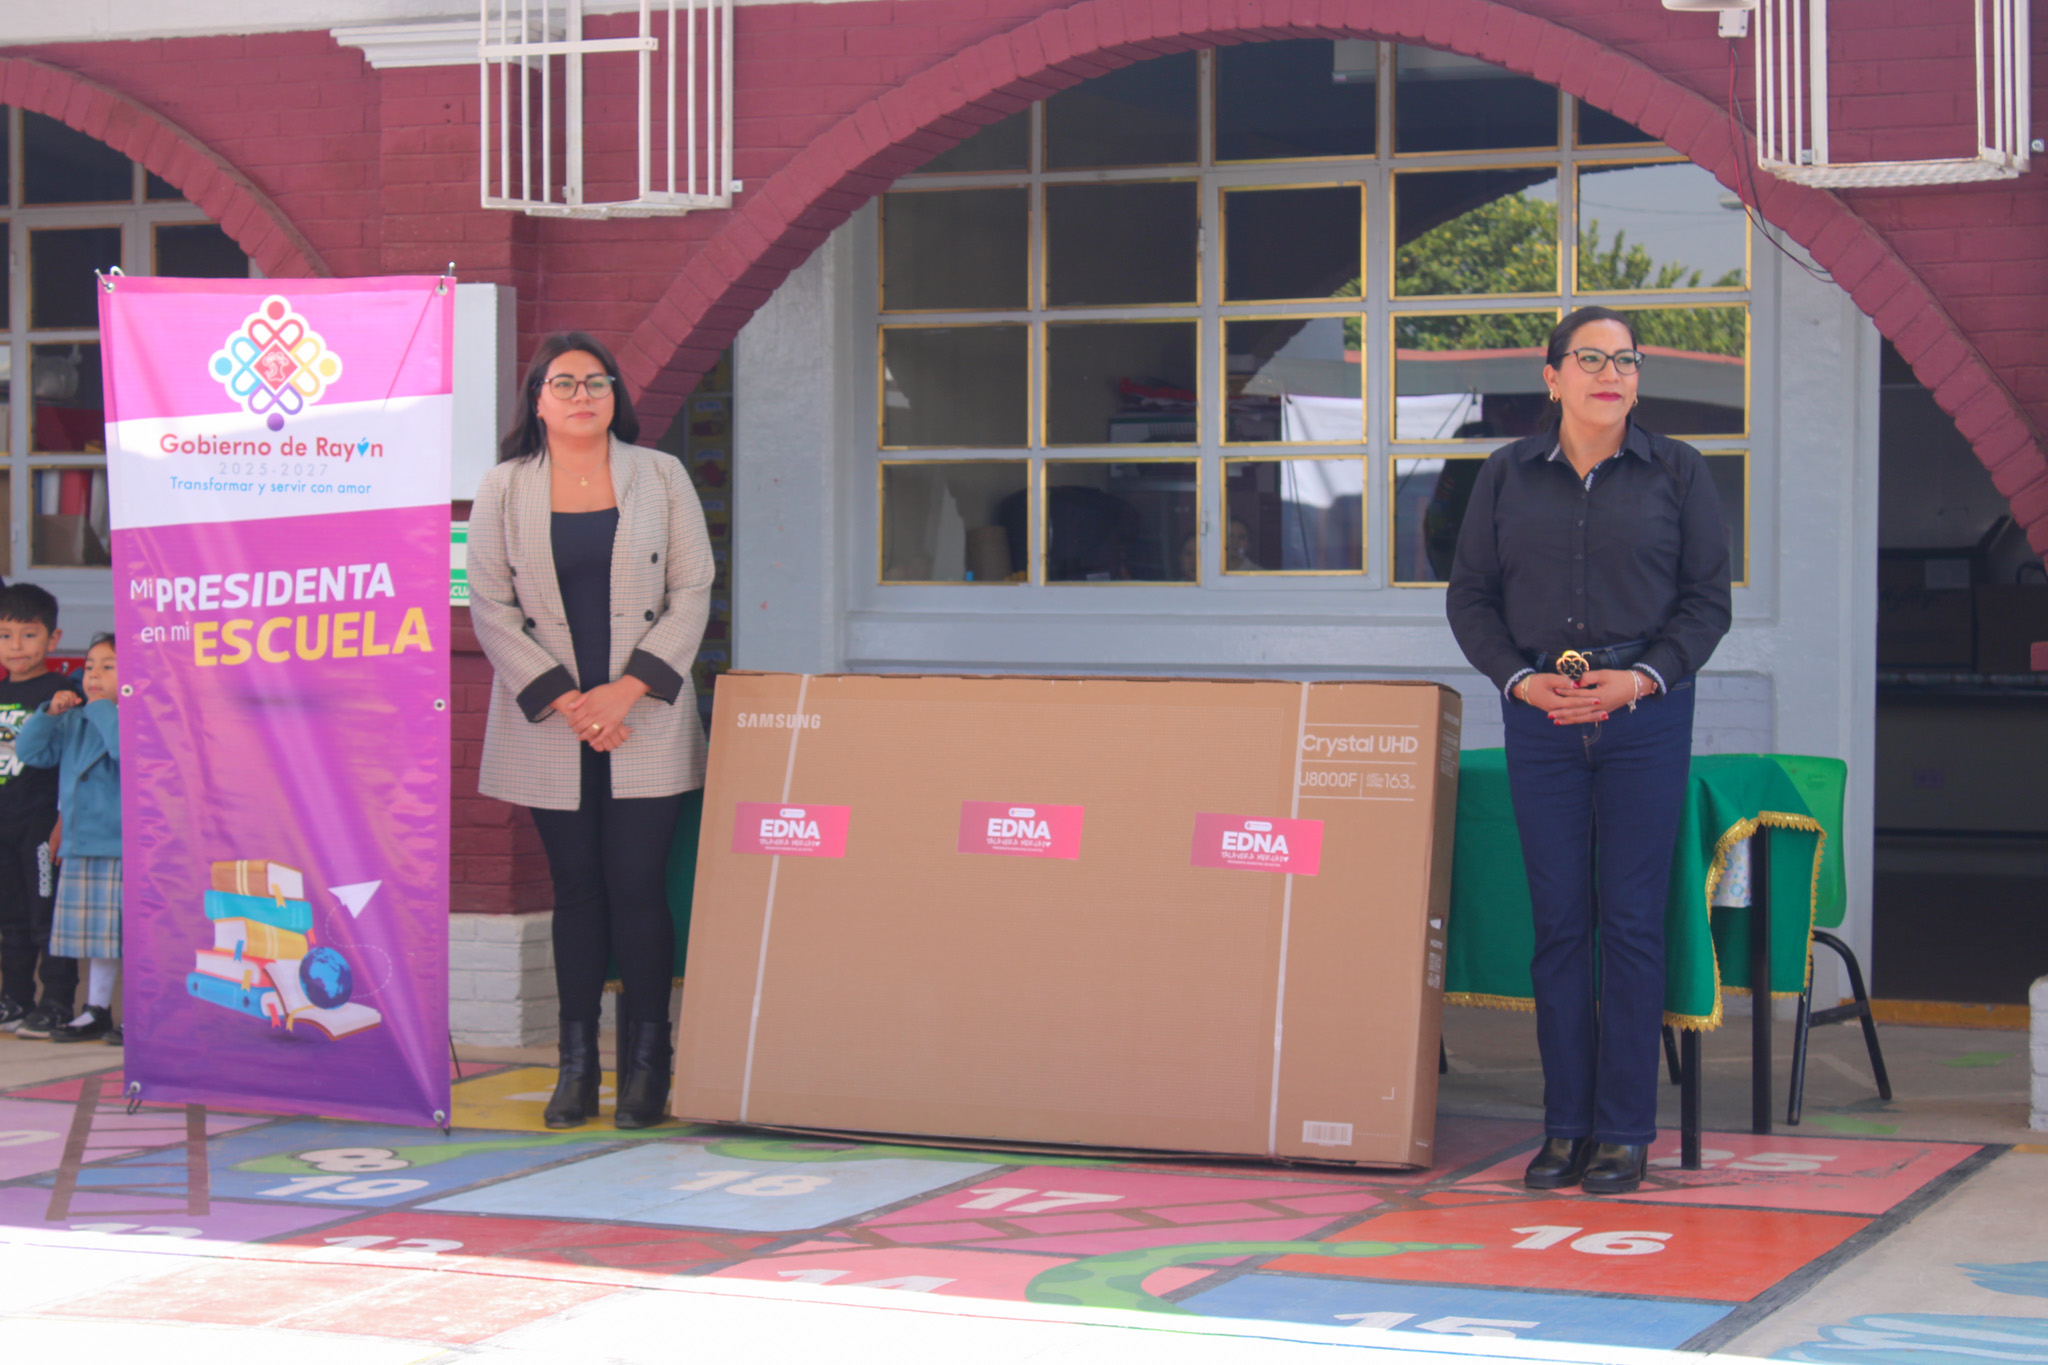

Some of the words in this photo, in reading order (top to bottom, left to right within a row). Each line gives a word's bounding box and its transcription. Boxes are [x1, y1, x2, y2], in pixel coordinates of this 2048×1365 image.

[160, 433, 271, 456] Gobierno
[281, 436, 307, 456] de
[218, 462, 328, 477] 2025-2027
[170, 476, 253, 493] Transformar
[258, 482, 266, 496] y
[270, 480, 306, 494] servir
[310, 482, 333, 494] con
[337, 482, 372, 495] amor
[130, 579, 153, 600] Mi
[156, 562, 395, 612] PRESIDENTA
[140, 625, 165, 643] en
[170, 621, 190, 642] mi
[193, 607, 433, 667] ESCUELA
[737, 712, 822, 729] SAMSUNG
[1301, 734, 1374, 758] Crystal
[1378, 735, 1419, 754] UHD
[759, 818, 821, 840] EDNA
[986, 818, 1051, 840] EDNA
[1222, 830, 1289, 855] EDNA
[255, 1175, 430, 1200] 19
[669, 1170, 833, 1197] 18
[956, 1187, 1125, 1213] 17
[1510, 1225, 1674, 1256] 16
